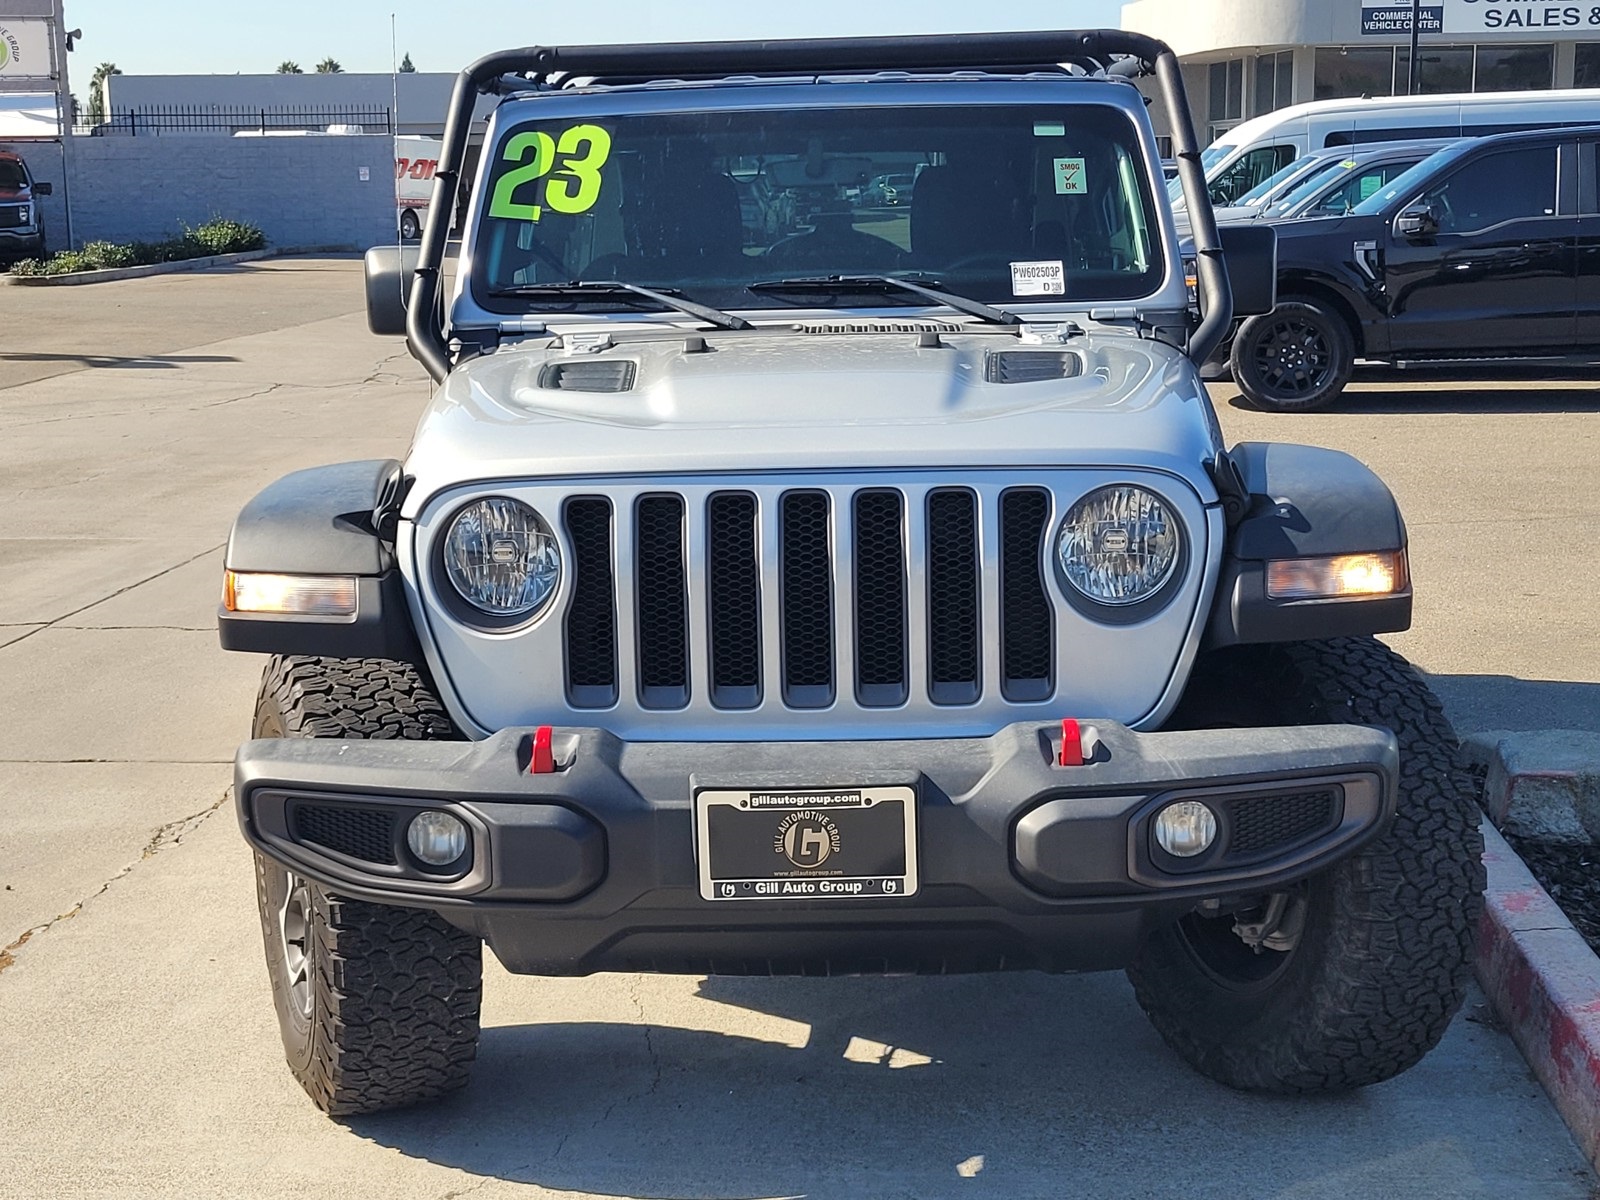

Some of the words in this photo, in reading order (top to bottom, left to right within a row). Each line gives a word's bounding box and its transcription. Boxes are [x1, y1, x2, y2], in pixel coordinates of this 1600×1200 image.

[1372, 11, 1434, 20] COMMERIAL
[1484, 7, 1581, 28] SALES
[1364, 21, 1403, 30] VEHICLE
[6, 34, 20, 62] GROUP
[488, 124, 611, 221] 23
[1060, 163, 1080, 171] SMOG
[1065, 182, 1078, 190] OK
[1013, 266, 1060, 278] PW602503P
[751, 794, 860, 807] gillautogroup.com
[777, 810, 830, 834] AUTOMOTIVE
[773, 834, 785, 853] GILL
[826, 823, 841, 853] GROUP
[755, 883, 779, 894] Gill
[782, 882, 815, 893] Auto
[819, 880, 862, 893] Group
